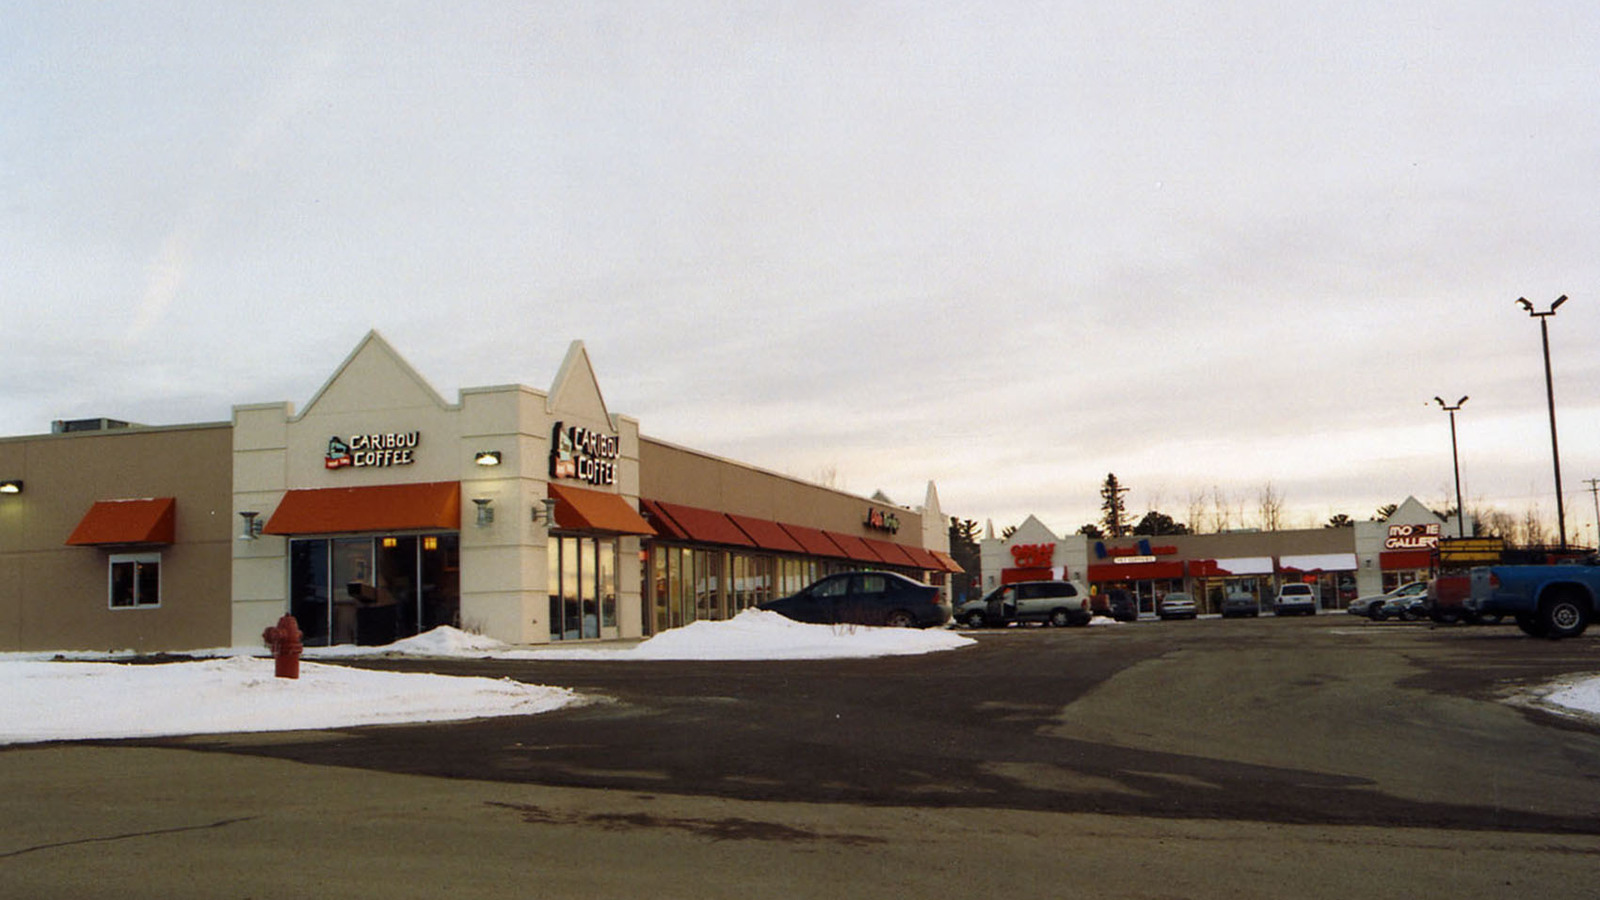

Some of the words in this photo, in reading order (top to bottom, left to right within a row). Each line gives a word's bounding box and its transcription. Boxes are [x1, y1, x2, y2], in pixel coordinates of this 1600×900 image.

[350, 432, 419, 450] CARIBOU
[572, 427, 620, 459] CARIBOU
[353, 450, 414, 467] COFFEE
[577, 455, 617, 485] COFFEE
